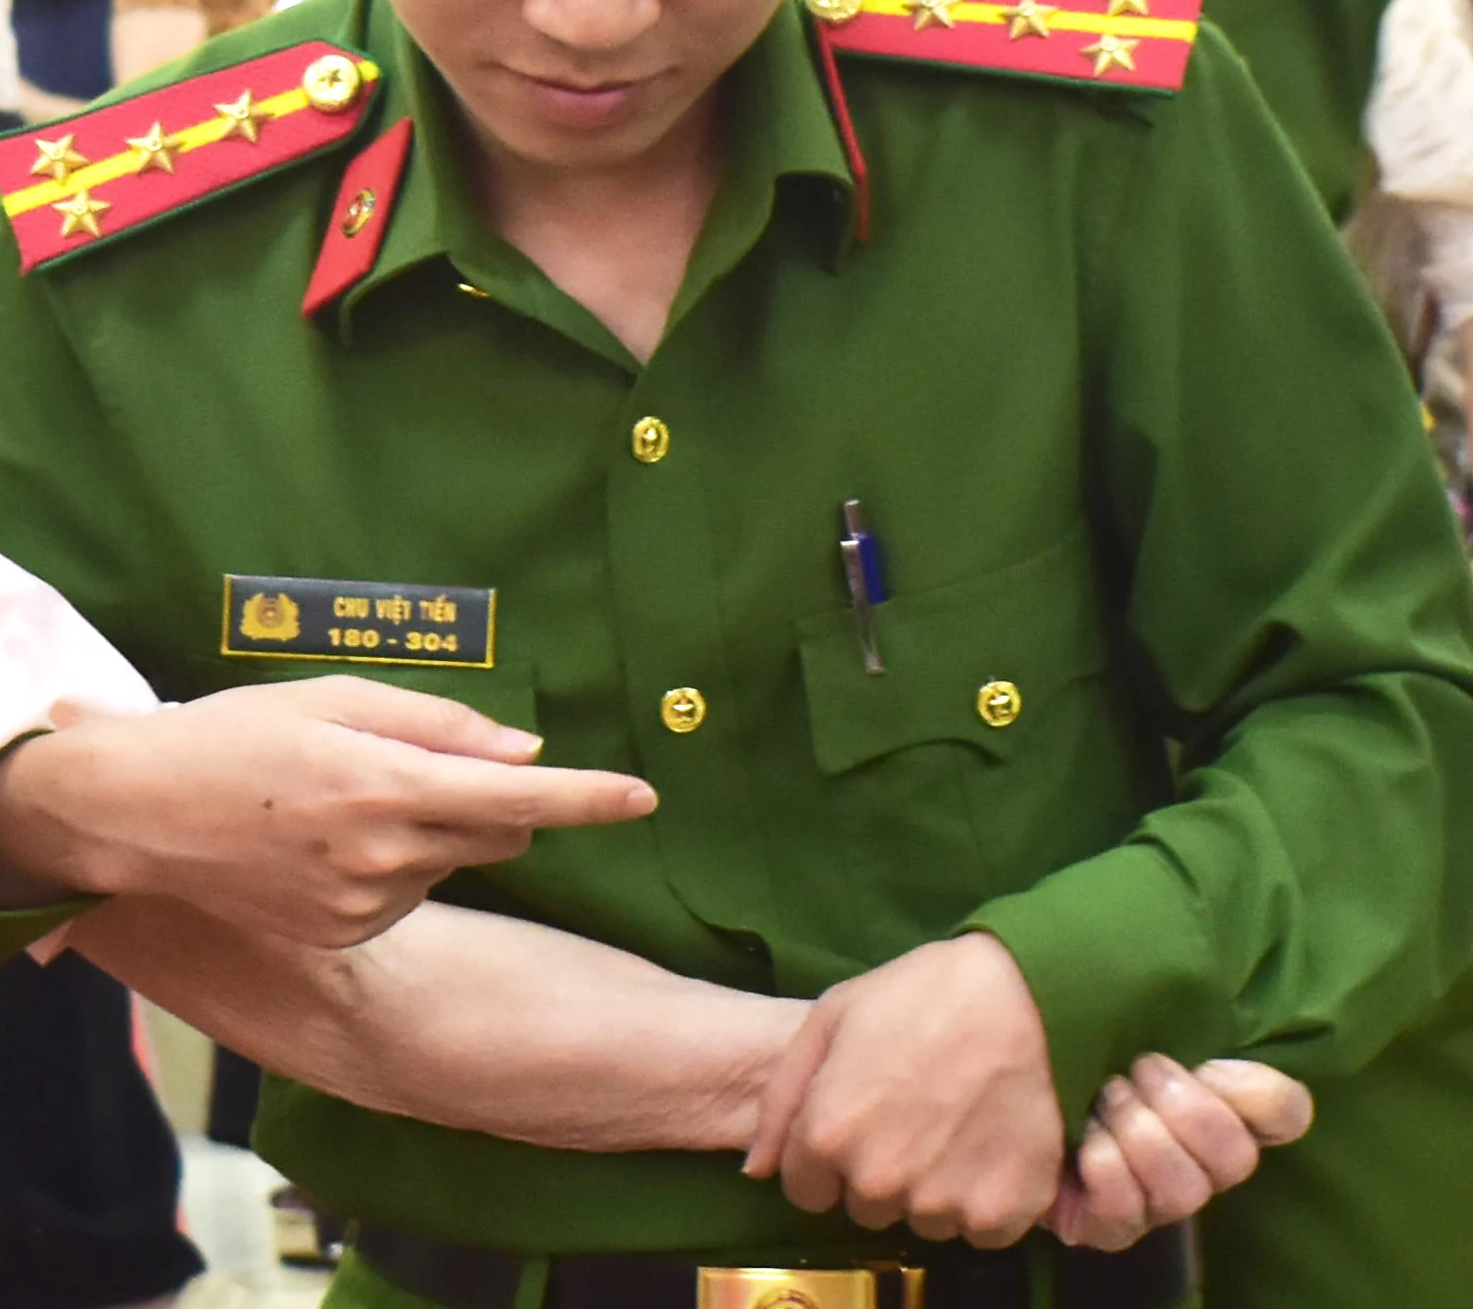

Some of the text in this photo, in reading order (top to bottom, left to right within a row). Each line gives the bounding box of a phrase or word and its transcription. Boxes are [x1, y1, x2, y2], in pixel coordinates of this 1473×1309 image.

[333, 596, 369, 618] CHU
[376, 594, 411, 625] VIỆT
[328, 628, 380, 648] 180
[406, 631, 457, 652] 304
